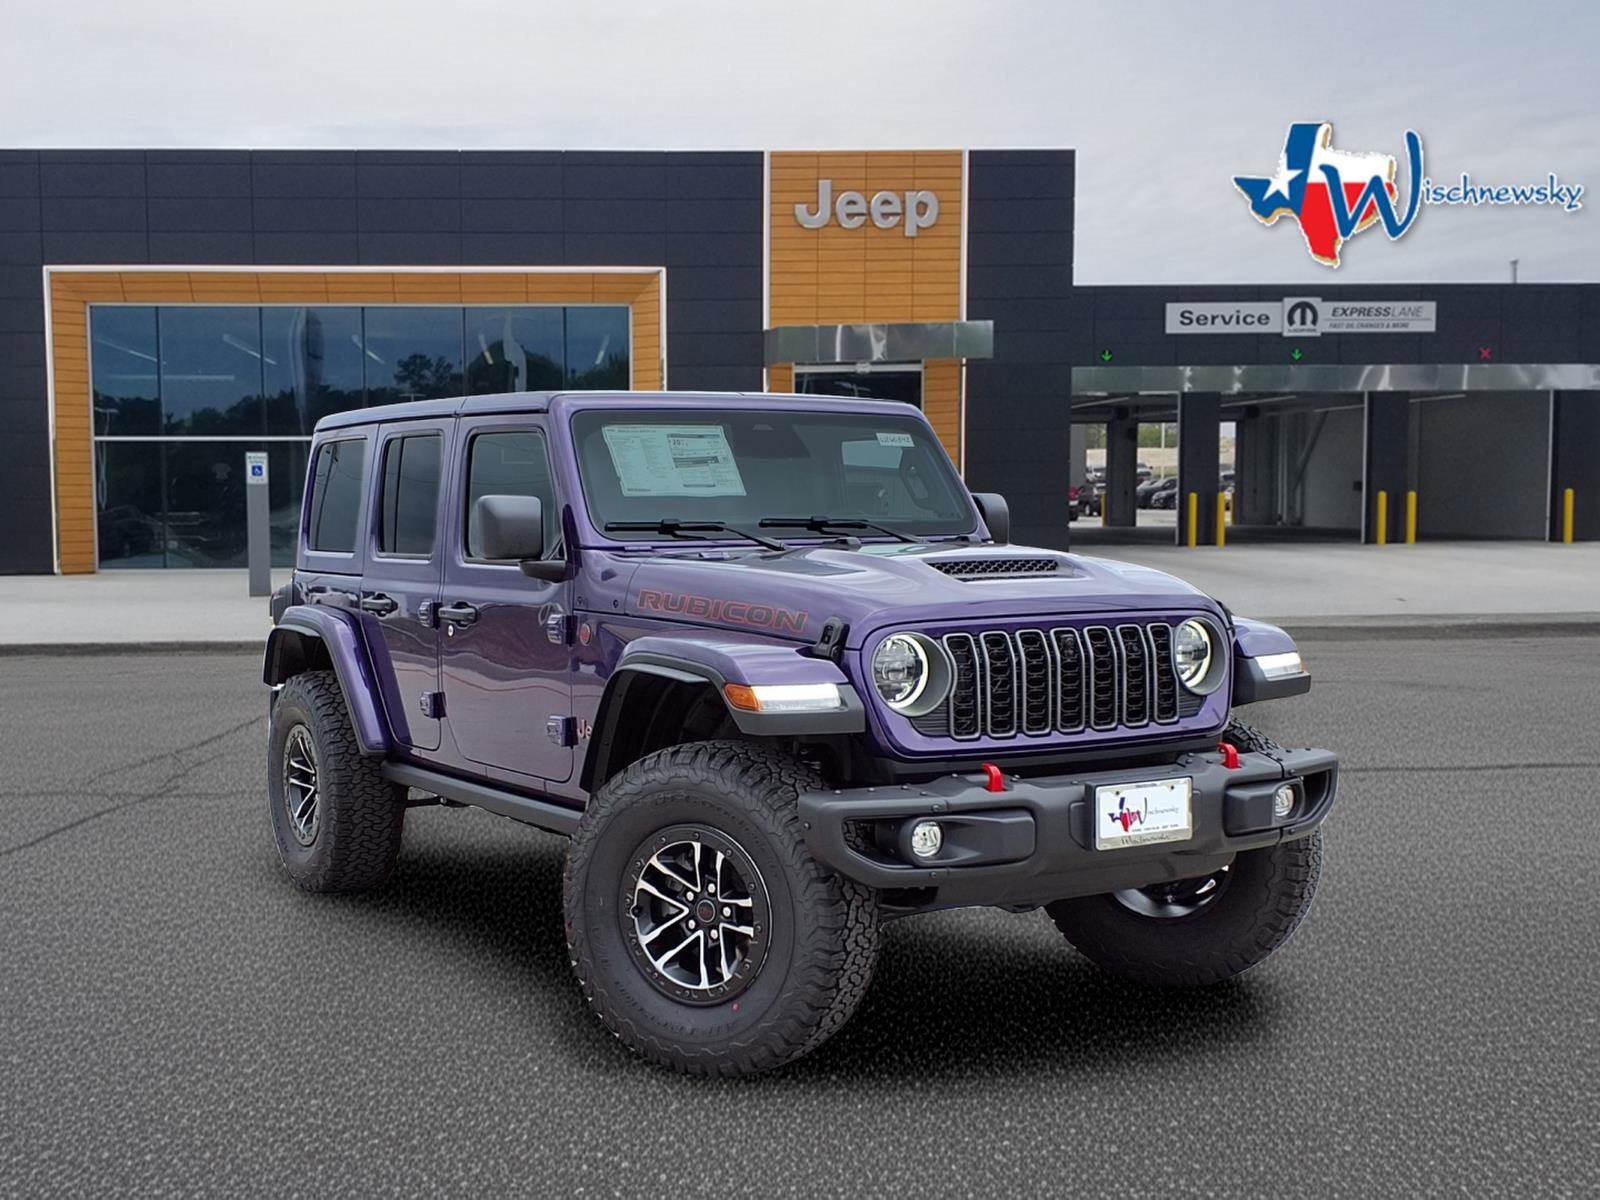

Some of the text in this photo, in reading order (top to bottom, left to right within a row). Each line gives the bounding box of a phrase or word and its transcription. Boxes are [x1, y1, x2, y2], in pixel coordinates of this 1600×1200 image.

[794, 179, 939, 237] Jeep
[1179, 309, 1271, 326] Service
[637, 588, 808, 634] RUBICON
[577, 719, 592, 740] Je
